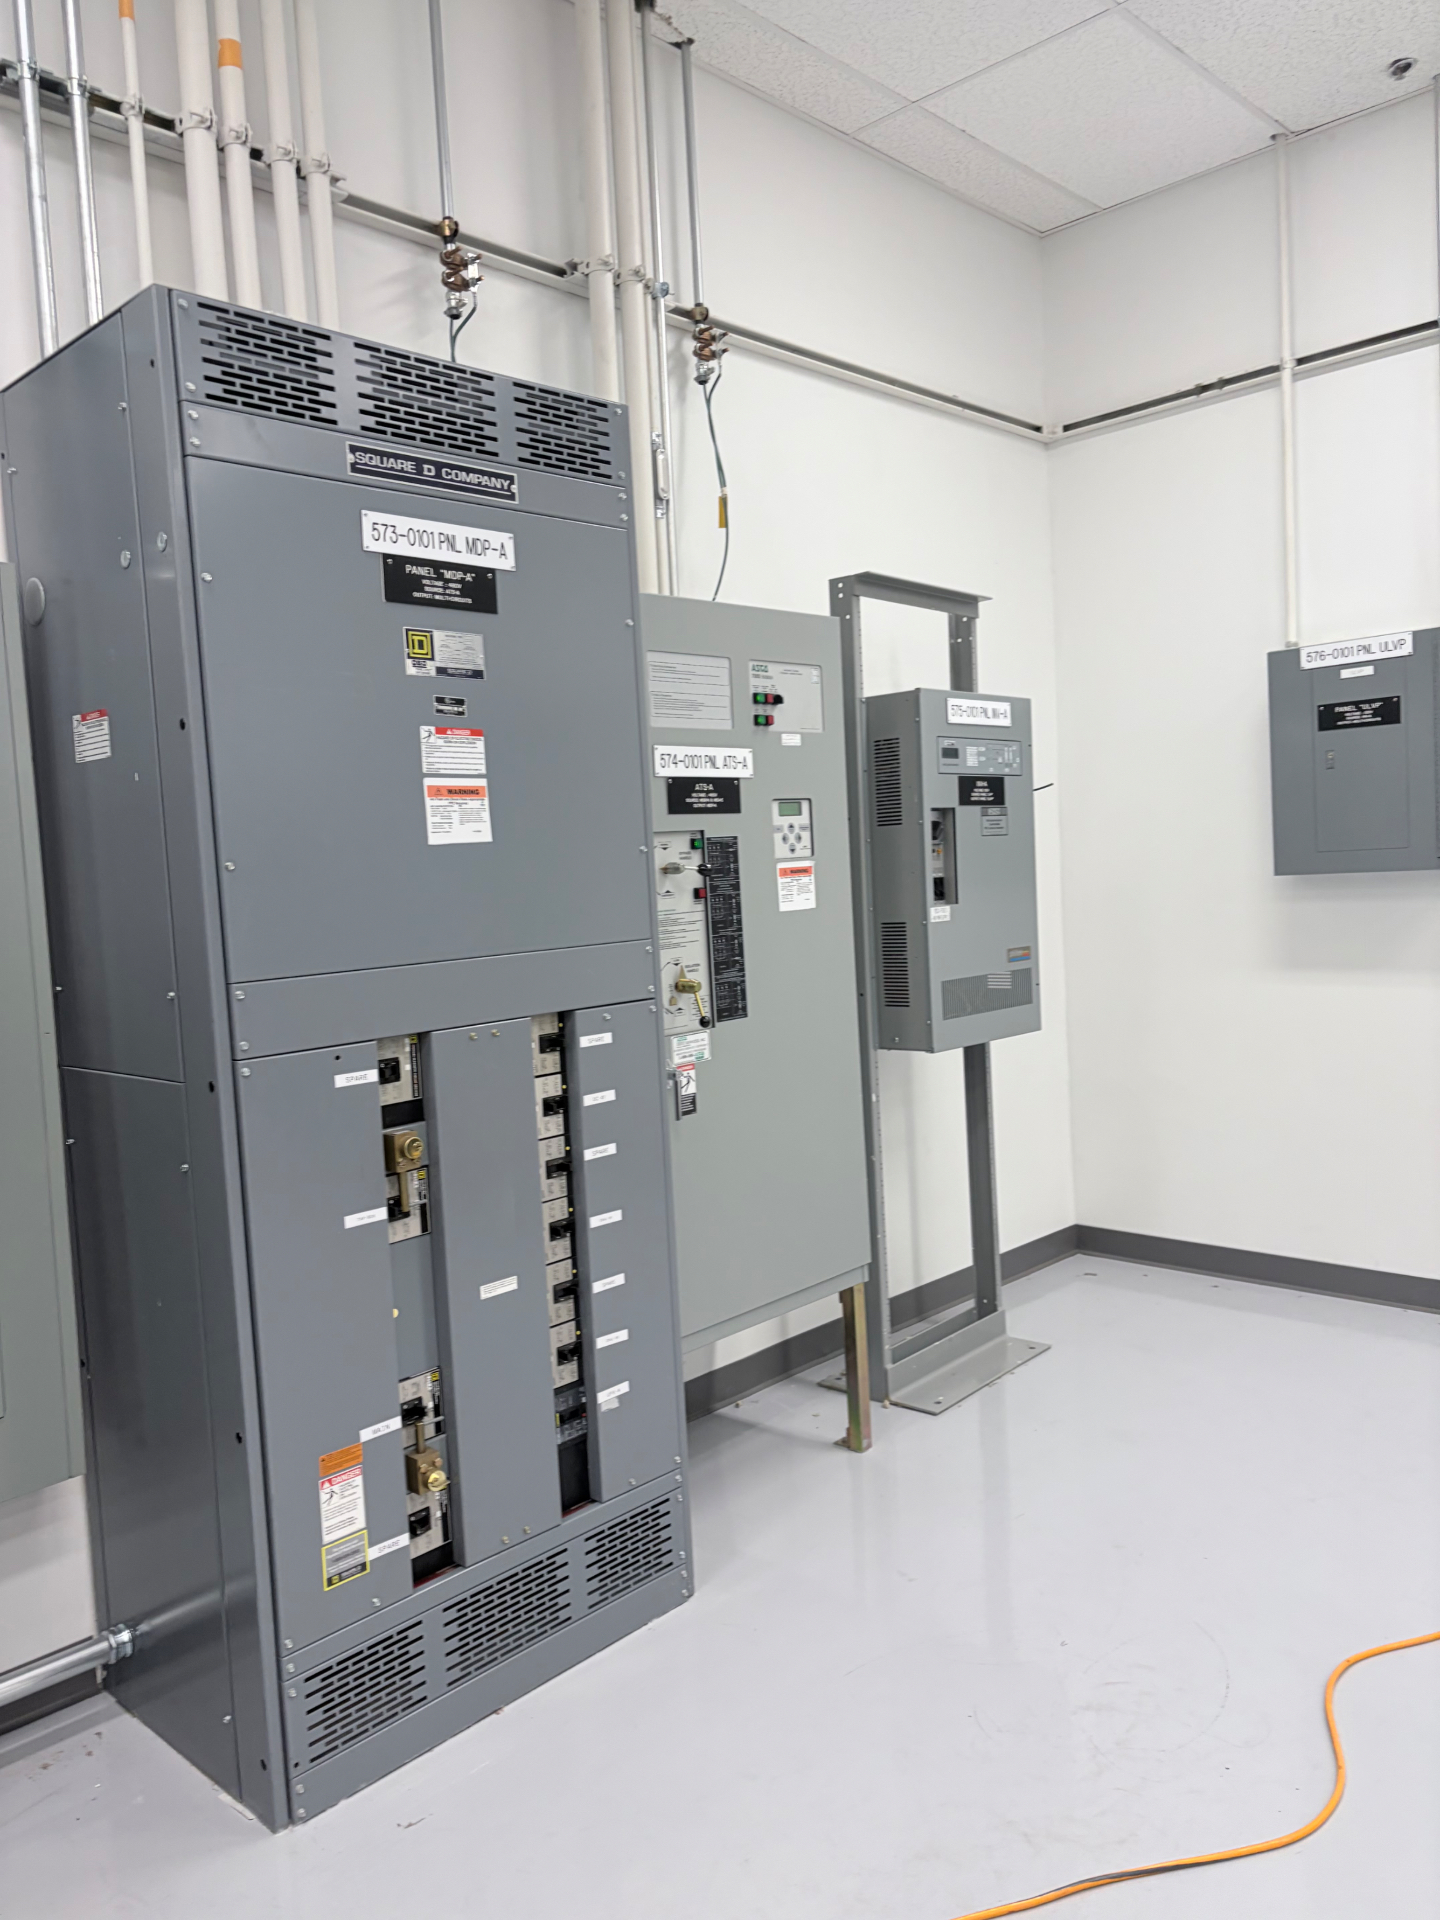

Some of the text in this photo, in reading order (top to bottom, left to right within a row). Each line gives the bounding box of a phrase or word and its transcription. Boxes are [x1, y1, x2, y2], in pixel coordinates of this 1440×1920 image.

[355, 452, 511, 490] SQUARE D COMPANY
[371, 522, 508, 560] 573-0101 PNL MDP-A
[405, 564, 476, 582] PANEL "MDP-A"
[1306, 639, 1407, 663] 576-0101 PNL ULVP
[660, 753, 748, 770] 574-0101 PNL ATS-A
[446, 788, 480, 796] WARNING
